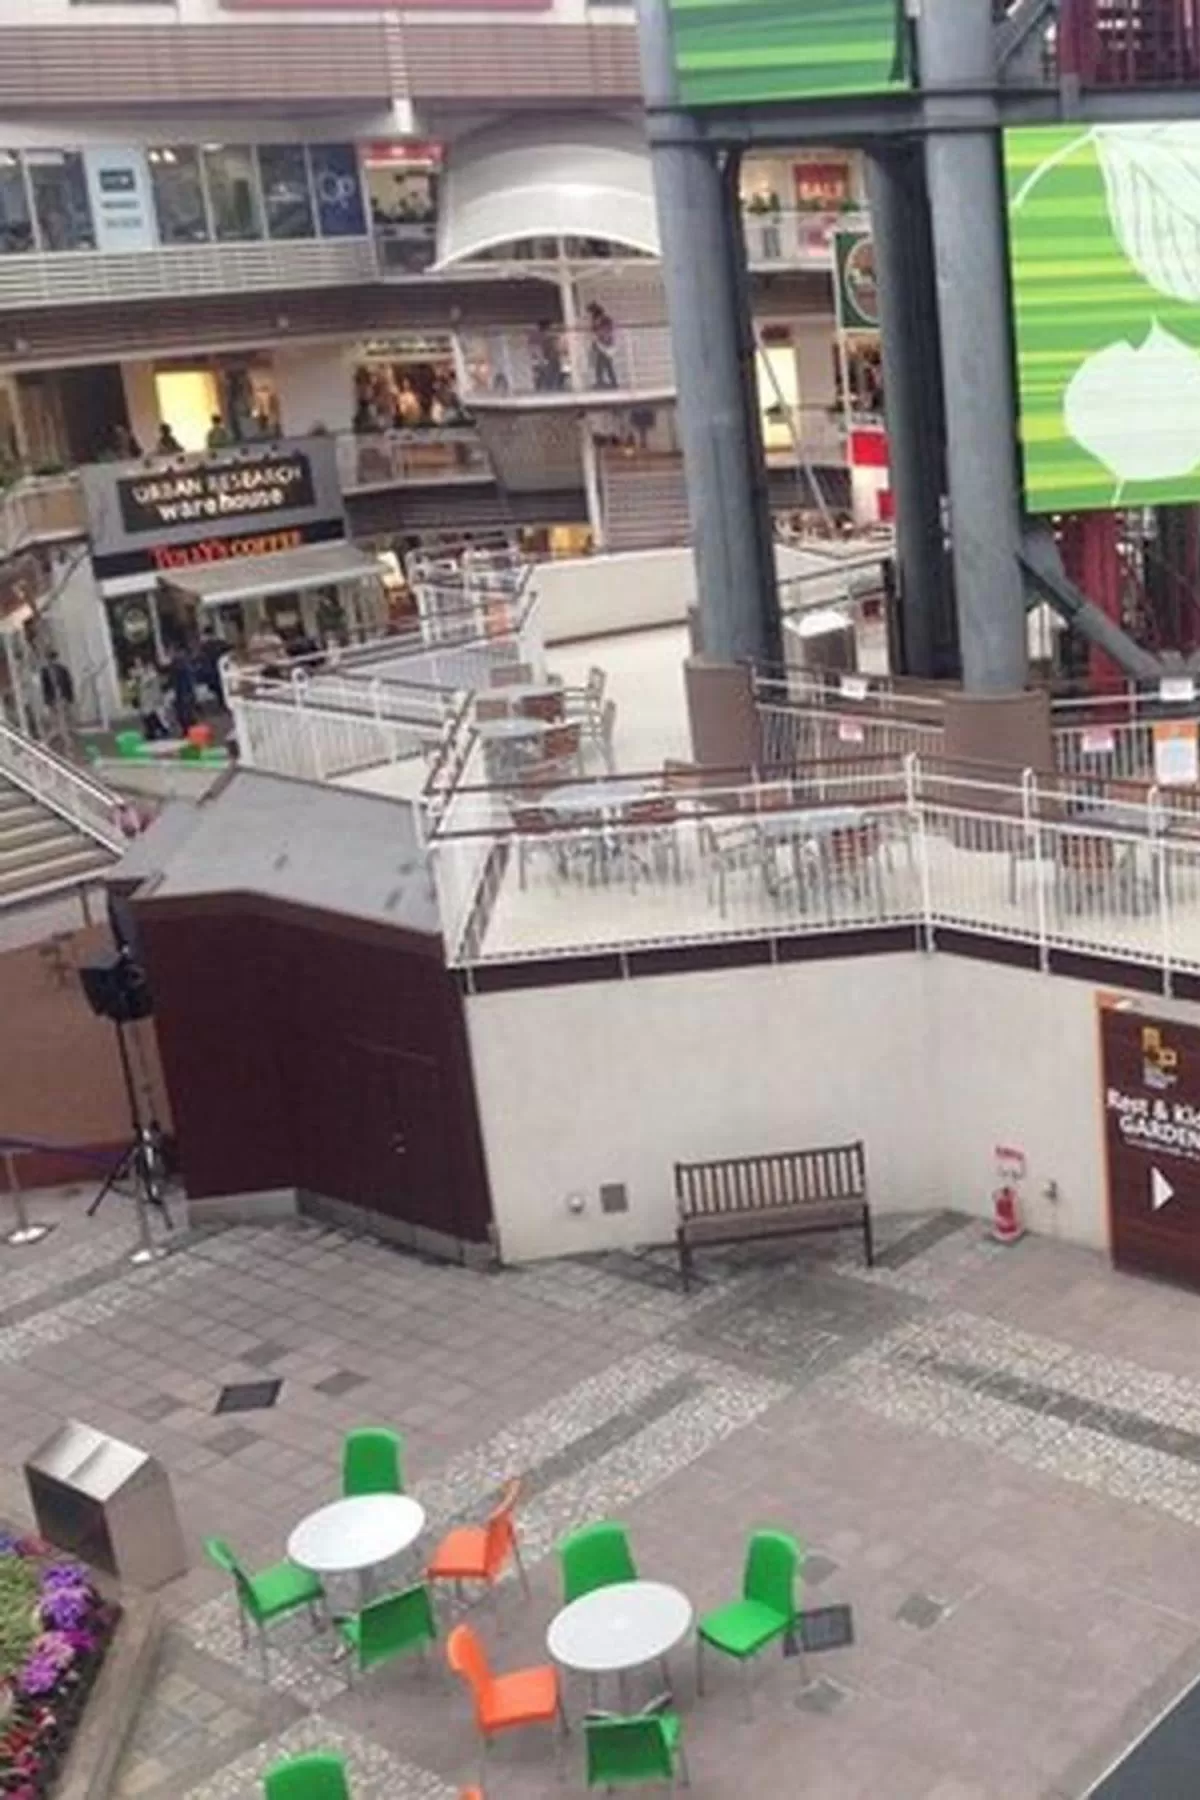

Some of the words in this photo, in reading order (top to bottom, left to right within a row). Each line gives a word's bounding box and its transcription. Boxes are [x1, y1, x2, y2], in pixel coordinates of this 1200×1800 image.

[134, 480, 202, 502] URBAN
[209, 465, 301, 492] RESEARCH
[157, 488, 285, 521] warehouse
[230, 530, 302, 556] COFFEE
[1107, 1087, 1149, 1118] Rest
[1152, 1099, 1169, 1120] &
